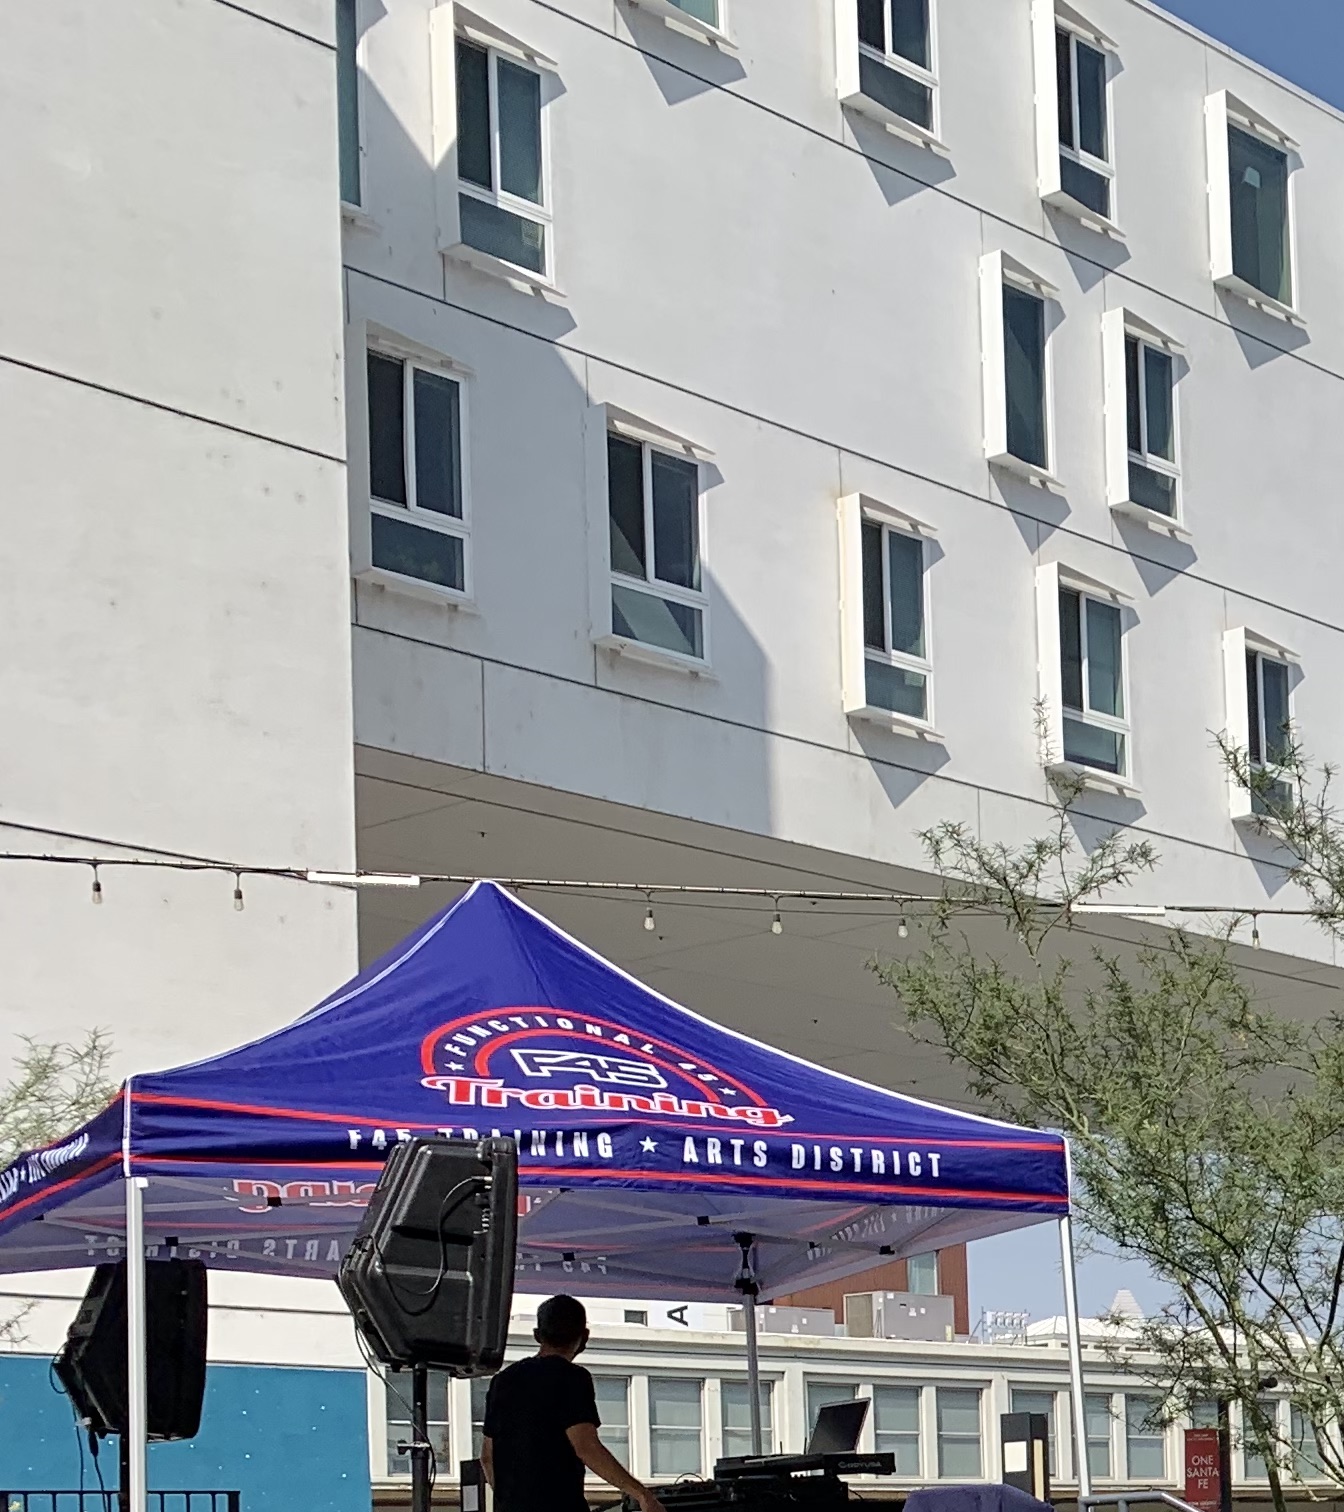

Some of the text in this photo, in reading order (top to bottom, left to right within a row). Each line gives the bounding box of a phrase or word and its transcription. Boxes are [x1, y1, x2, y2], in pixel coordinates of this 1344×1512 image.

[447, 1014, 655, 1057] FUNCTIONAL
[509, 1047, 668, 1089] F45
[420, 1075, 795, 1128] Training
[682, 1136, 768, 1168] ARTS
[792, 1146, 942, 1178] DISTRICT
[1186, 1466, 1219, 1478] SANTA
[1192, 1455, 1214, 1466] ONE
[1198, 1479, 1209, 1489] FE
